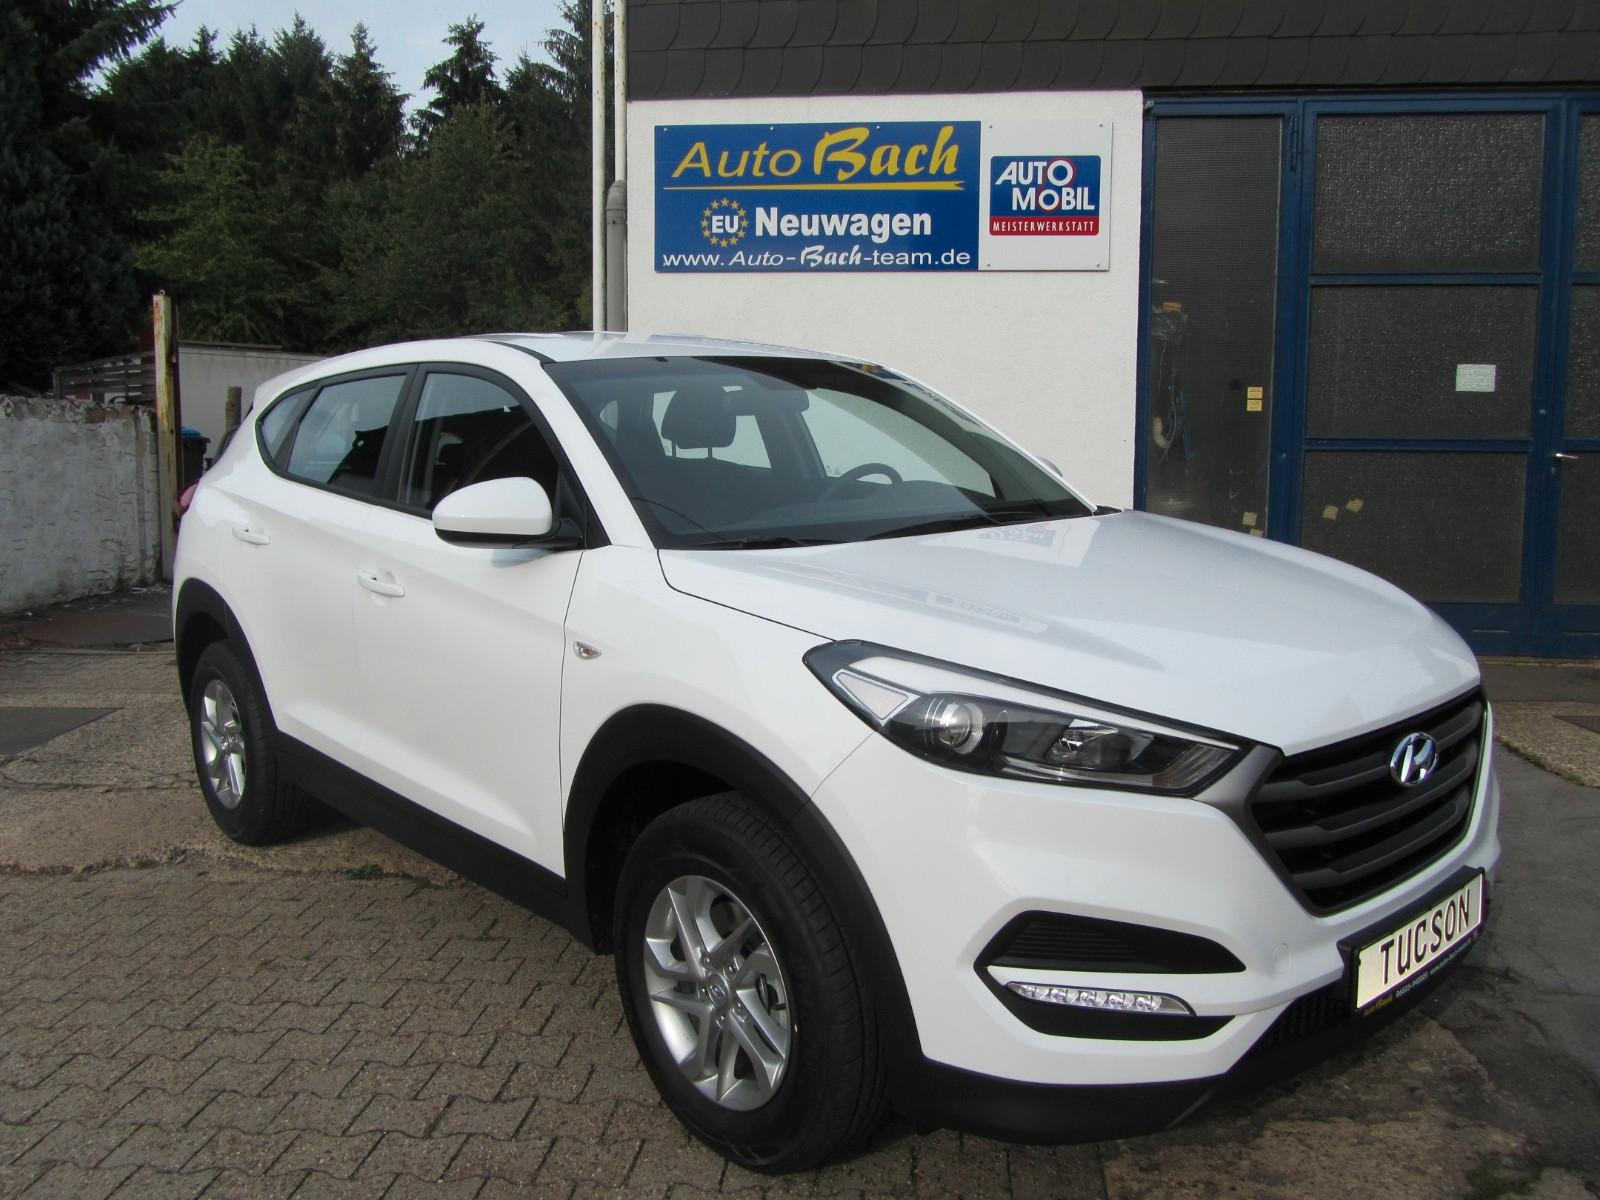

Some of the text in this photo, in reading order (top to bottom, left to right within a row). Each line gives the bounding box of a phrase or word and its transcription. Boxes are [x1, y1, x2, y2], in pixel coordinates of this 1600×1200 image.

[672, 125, 959, 182] Auto Bach
[995, 159, 1075, 188] AUTO
[1012, 187, 1095, 212] MOBIL
[711, 207, 932, 242] EU Neuwagen
[993, 221, 1095, 233] MEISTERWERKSTATT
[1379, 888, 1470, 985] TUCSON
